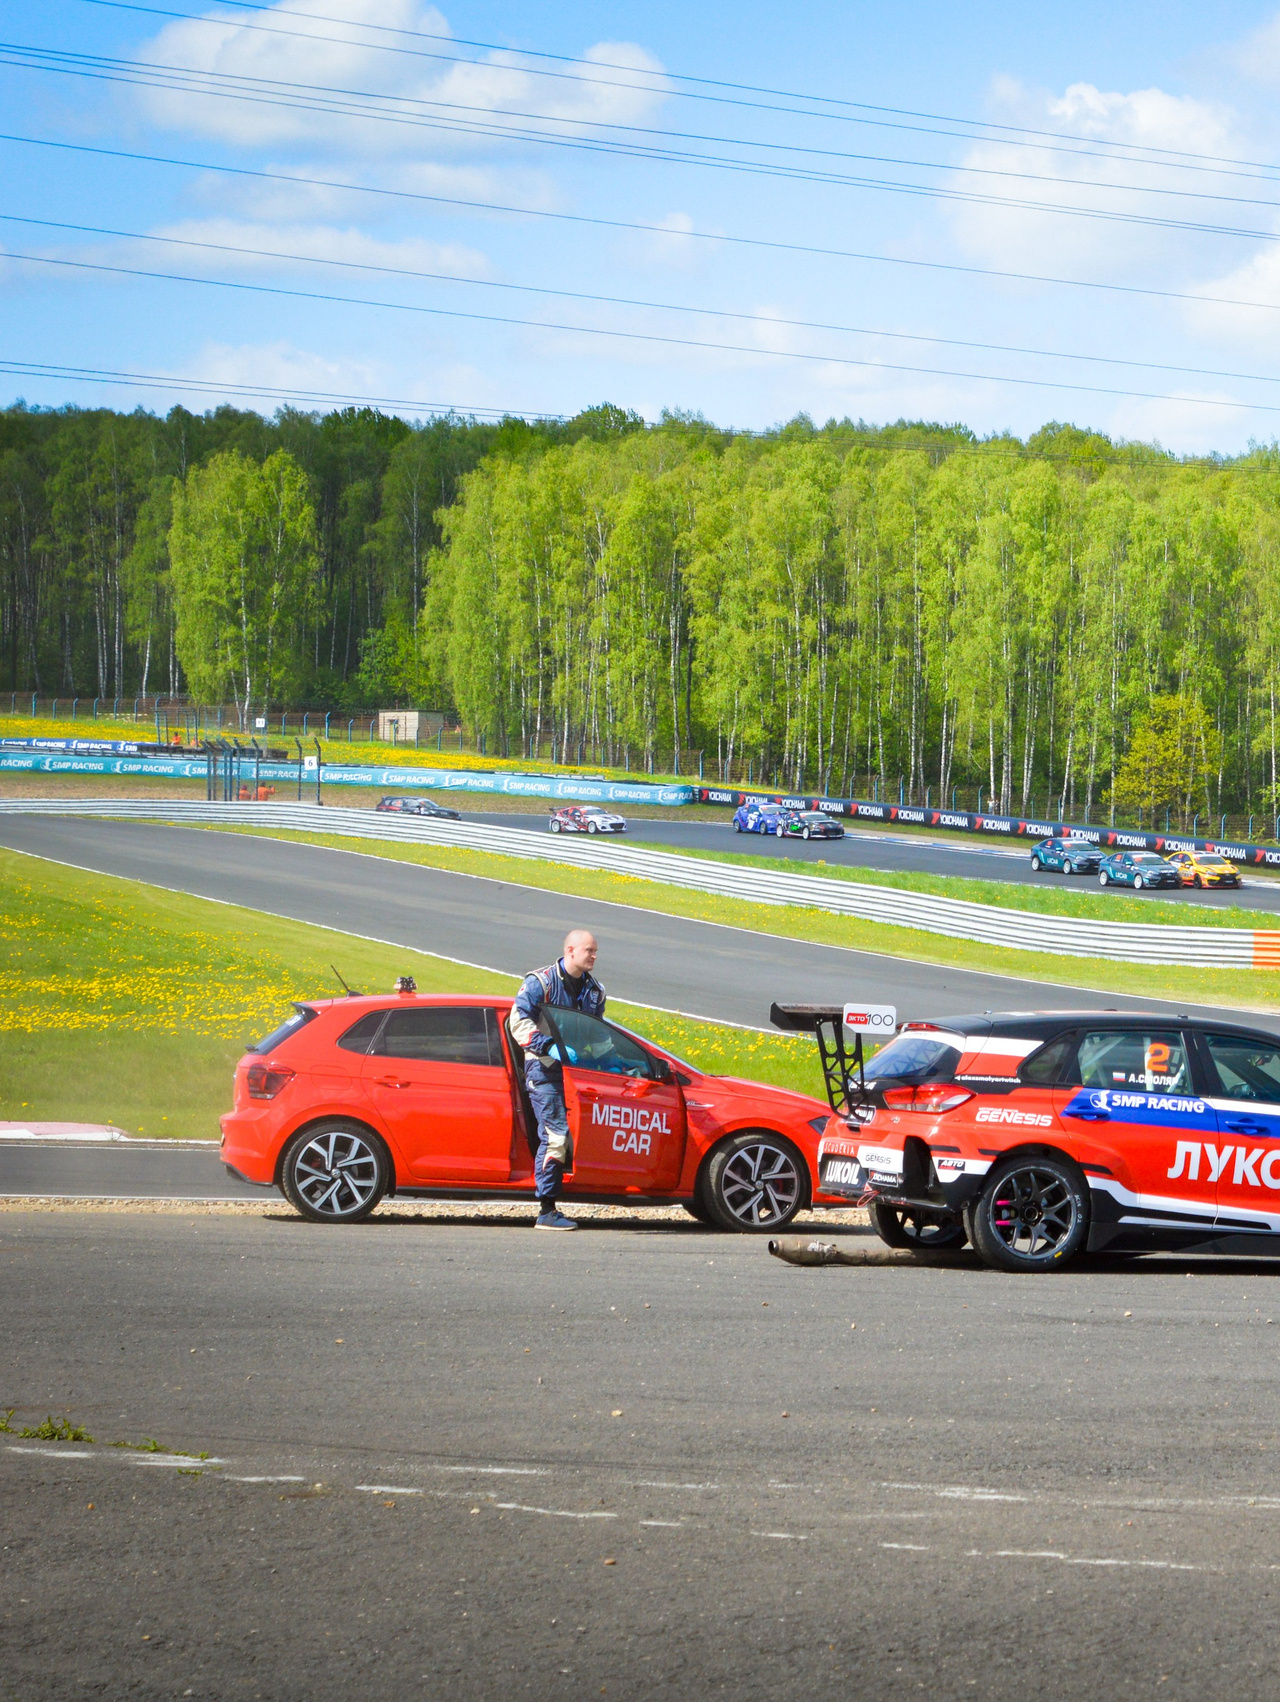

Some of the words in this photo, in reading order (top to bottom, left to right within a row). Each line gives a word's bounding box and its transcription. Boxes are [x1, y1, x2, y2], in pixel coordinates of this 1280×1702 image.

[52, 761, 71, 769] SMP
[72, 762, 104, 770] RACING
[143, 765, 174, 773] RACING
[343, 773, 372, 782] RACING
[389, 775, 406, 783] SMP
[407, 776, 435, 784] RACING
[467, 779, 494, 788] RACING
[509, 782, 524, 790] SMP
[524, 783, 550, 792] RACING
[563, 786, 578, 794] SMP
[578, 786, 601, 796] RACING
[628, 790, 651, 799] RACING
[663, 792, 677, 800] SMP
[708, 791, 732, 803] YOKOHAMA
[781, 799, 806, 809] YOKOHAMA
[819, 802, 844, 812] YOKOHAMA
[858, 804, 884, 817] YOKOHAMA
[898, 809, 925, 822] YOKOHAMA
[940, 814, 968, 827] YOKOHAMA
[983, 819, 1011, 832] YOKOHAMA
[1026, 824, 1054, 836] YOKOHAMA
[1071, 829, 1100, 842] YOKOHAMA
[1116, 834, 1146, 847] YOKOHAMA
[1164, 840, 1195, 851] YOKOHAMA
[1214, 846, 1246, 860] YOKOHAMA
[867, 1013, 894, 1026] 100
[1146, 1043, 1170, 1072] 2
[1128, 1073, 1178, 1086] А.СОЛЯ
[1112, 1094, 1145, 1107] SMP
[1147, 1097, 1205, 1113] RACING
[592, 1103, 671, 1134] MEDICAL
[975, 1111, 1053, 1127] GENESIS
[612, 1130, 651, 1155] CAR
[824, 1142, 855, 1155] SCUDERIA
[865, 1154, 891, 1165] GENESIS
[825, 1161, 860, 1185] LUKOIL
